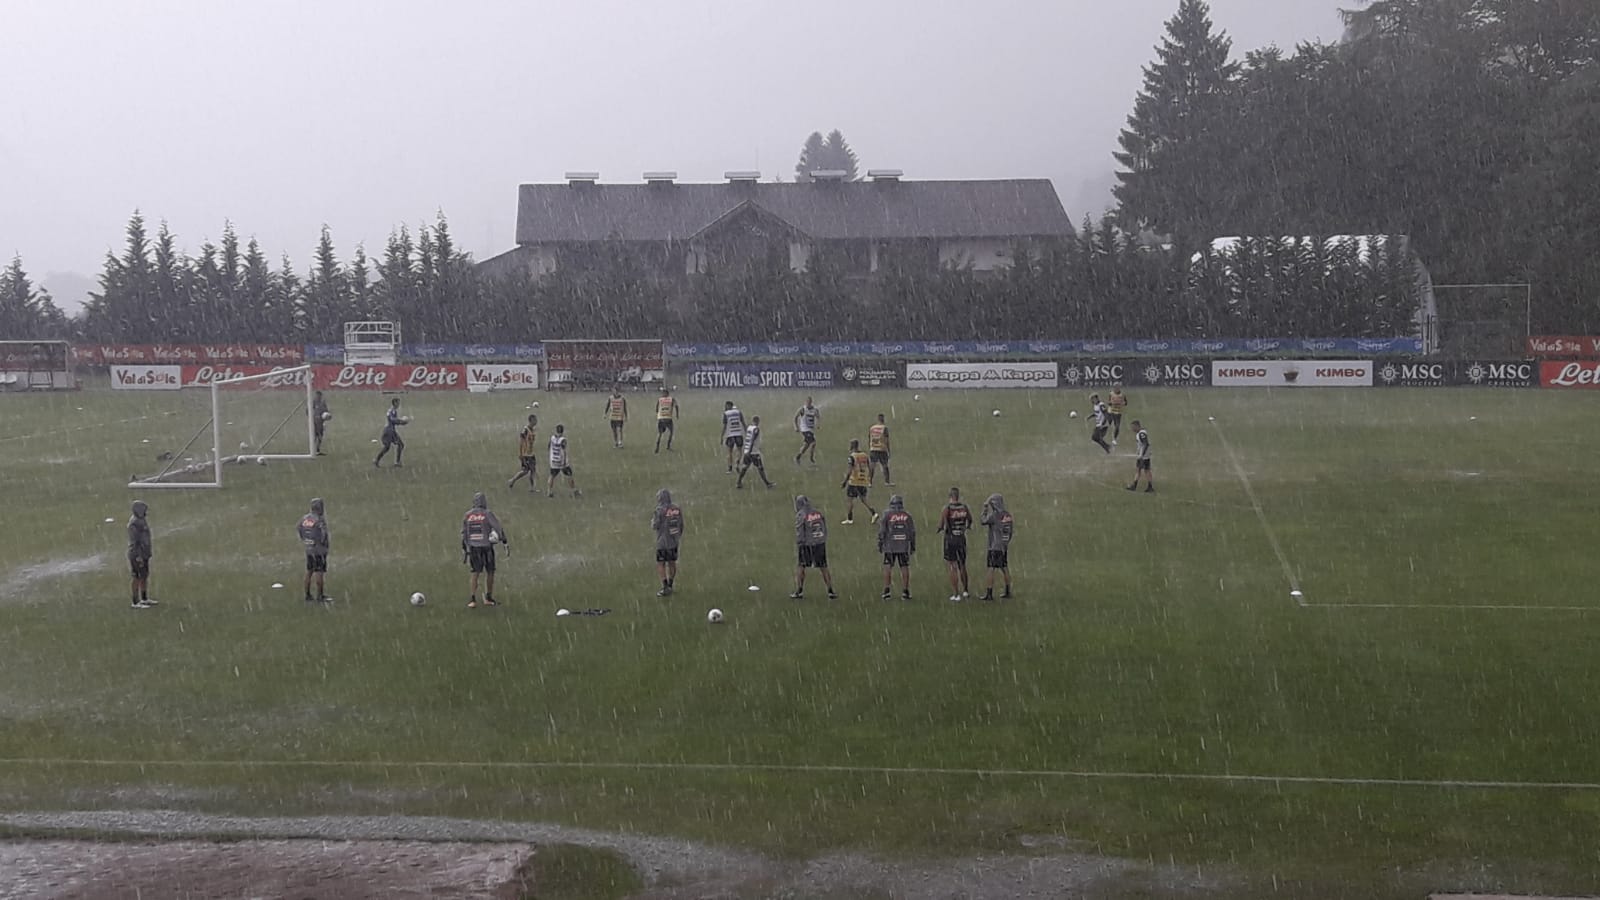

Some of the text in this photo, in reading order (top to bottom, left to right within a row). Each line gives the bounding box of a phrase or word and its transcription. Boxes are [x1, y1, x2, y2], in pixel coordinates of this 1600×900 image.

[117, 370, 136, 384] Val
[331, 366, 386, 387] Lete
[403, 366, 458, 387] Lete
[472, 369, 492, 383] Val
[927, 370, 981, 382] Kappa
[1002, 369, 1055, 381] Kappa
[1084, 365, 1124, 379] MSC
[1164, 365, 1204, 379] MSC
[1218, 368, 1267, 377] KIMBO
[1316, 368, 1365, 377] KIMBO
[1401, 364, 1442, 378] MSC
[1488, 364, 1530, 378] MSC
[1550, 362, 1600, 386] Let
[695, 371, 744, 387] FESTIVAL
[760, 371, 794, 387] SPORT
